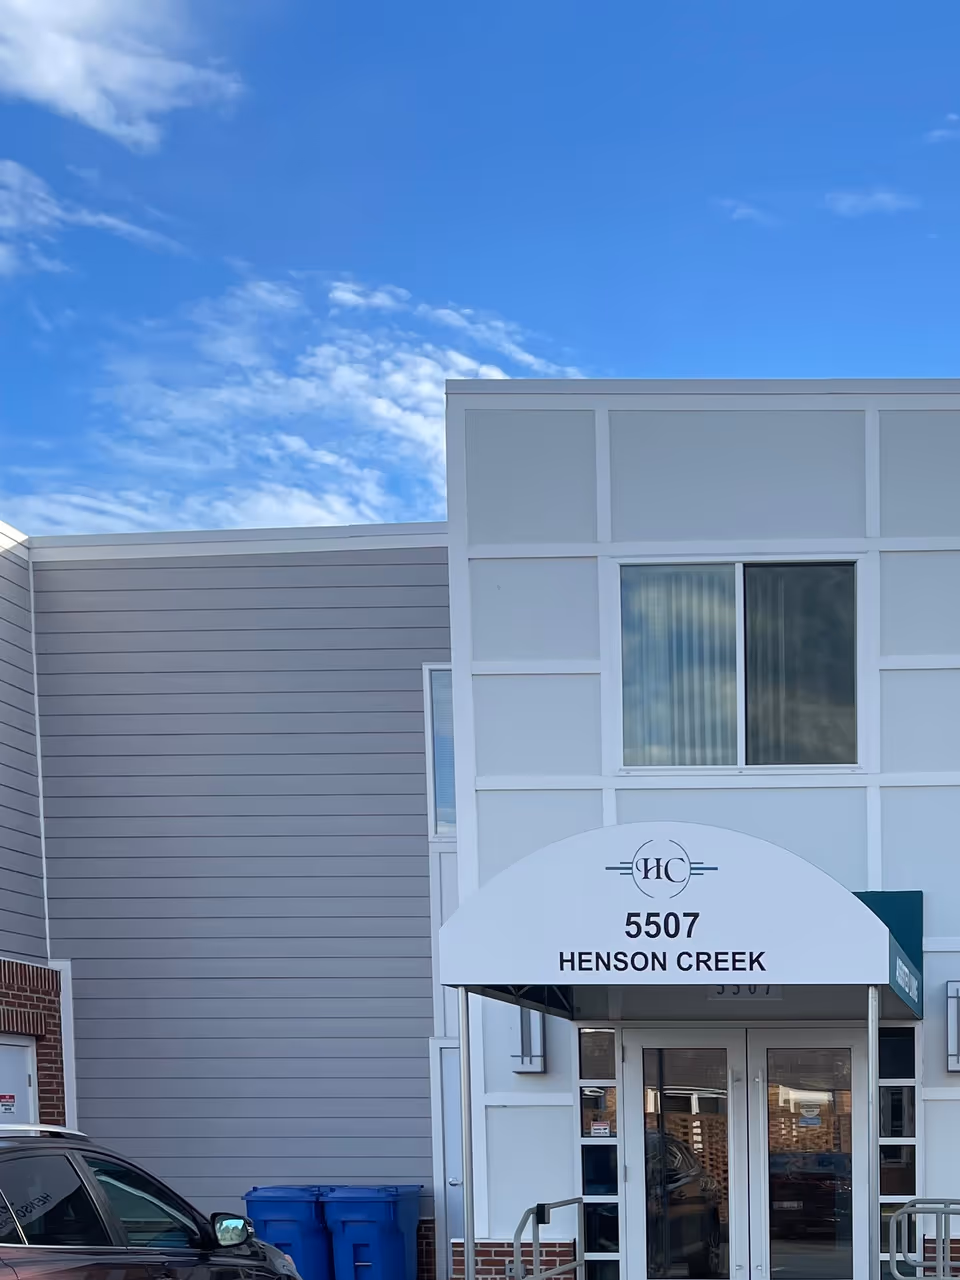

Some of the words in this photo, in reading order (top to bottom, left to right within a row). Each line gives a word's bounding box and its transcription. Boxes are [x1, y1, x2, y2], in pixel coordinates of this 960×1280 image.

[636, 857, 687, 883] HC
[624, 911, 700, 939] 5507
[559, 951, 667, 972] HENSON
[676, 951, 766, 972] CREEK
